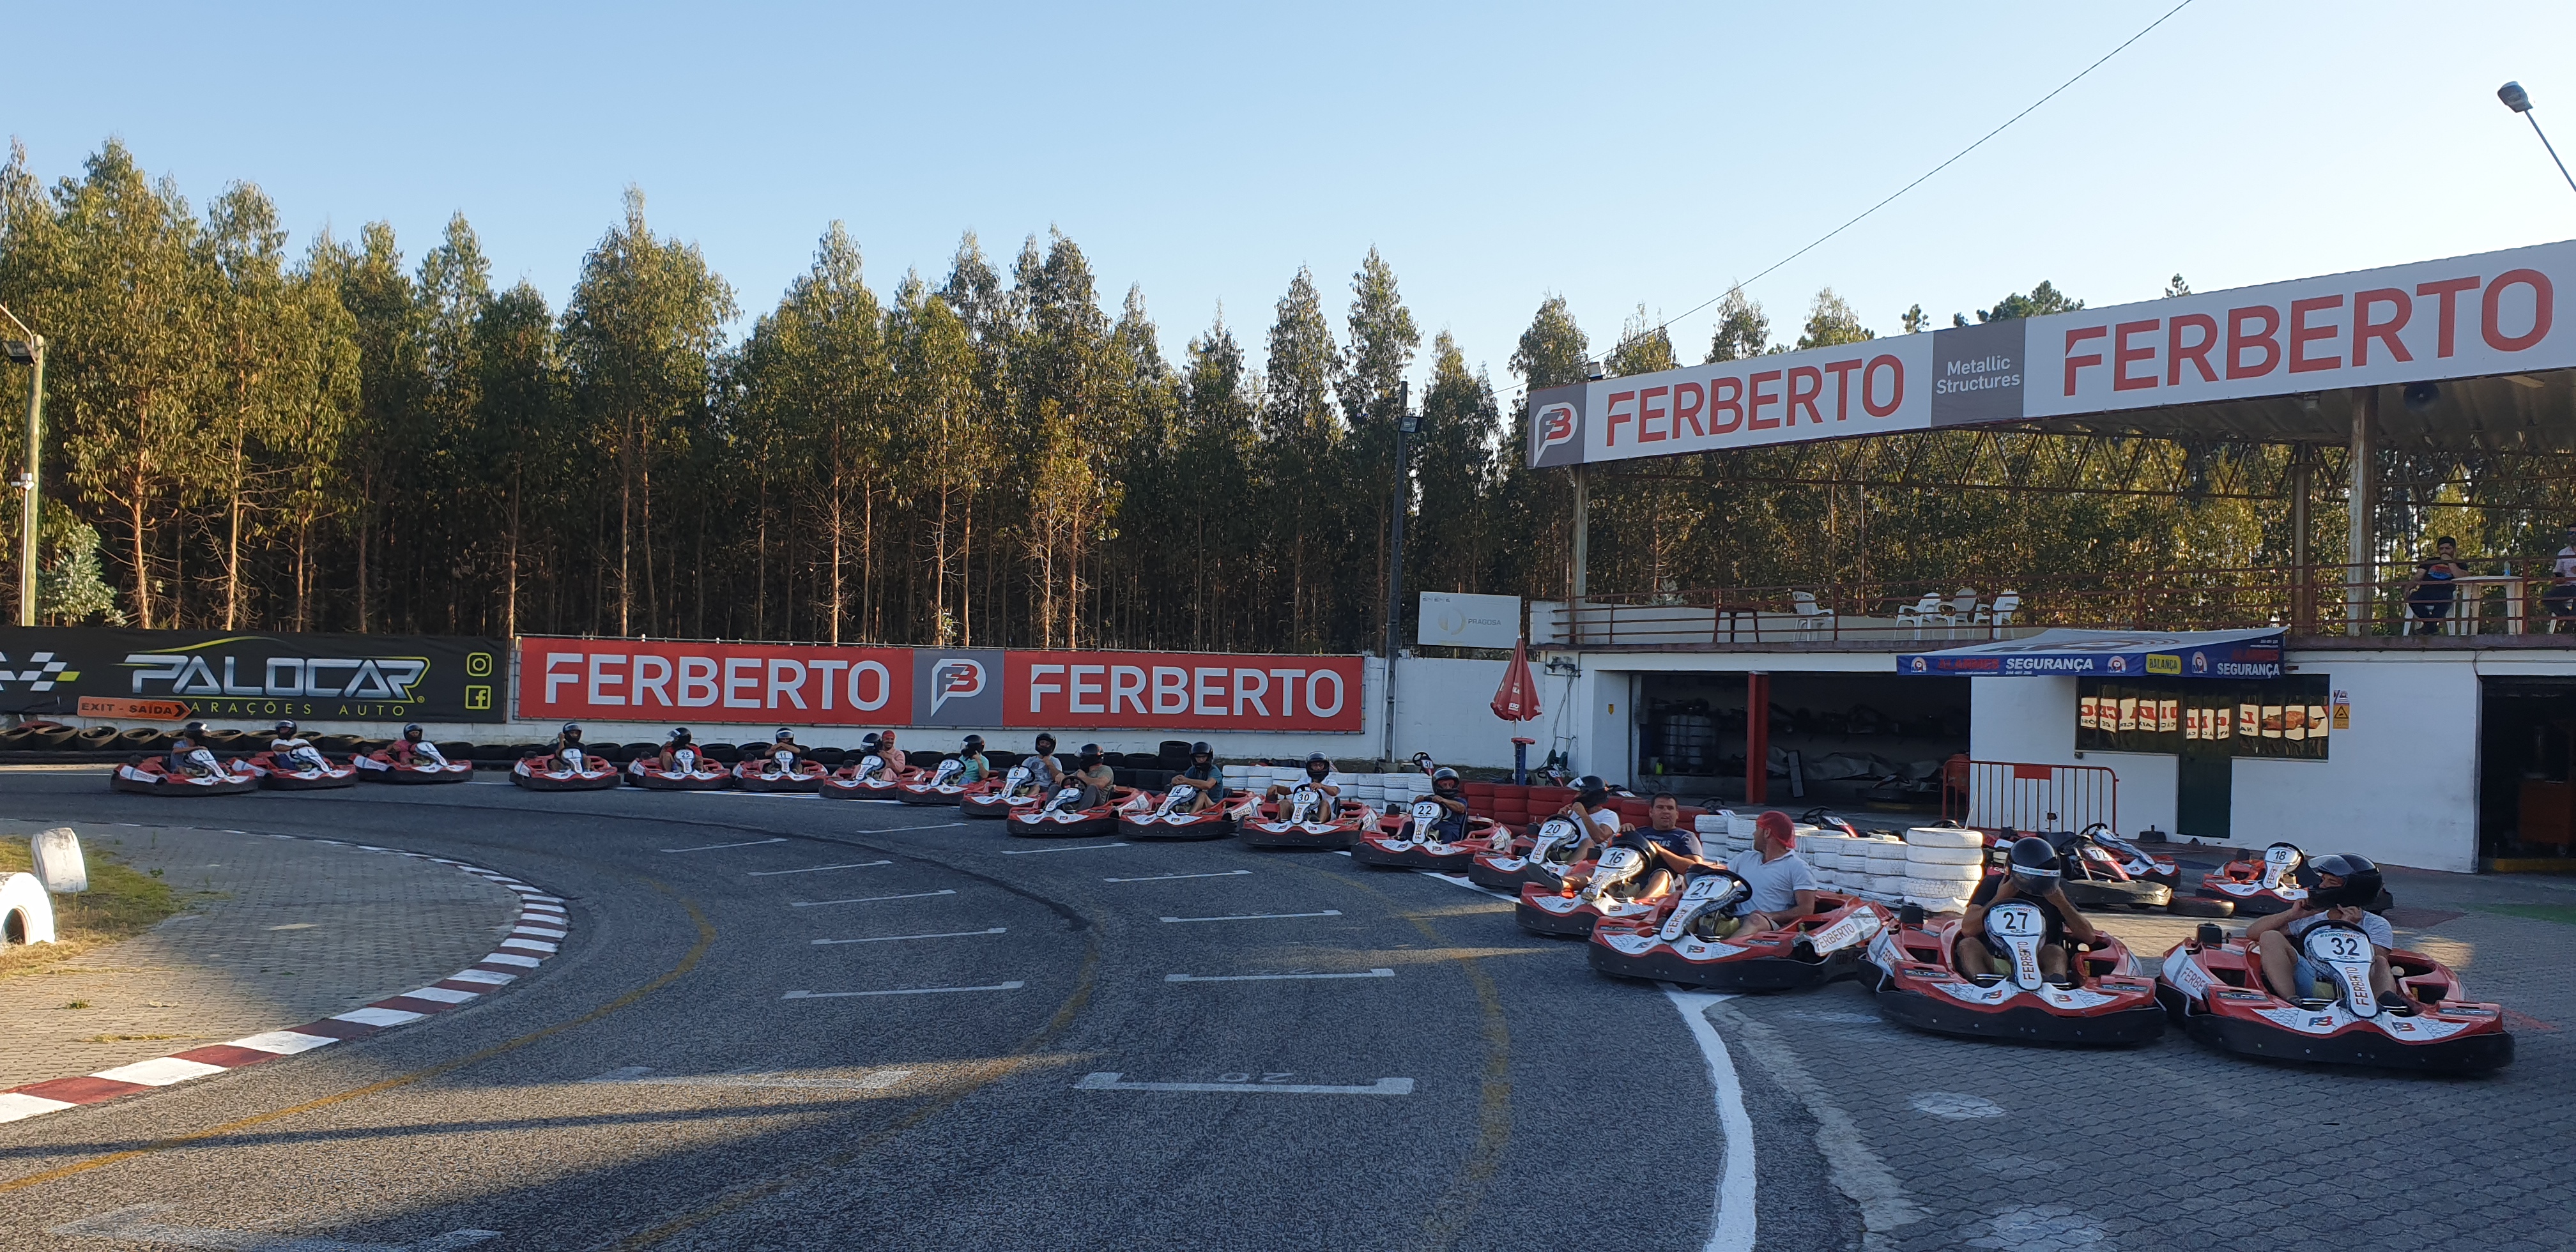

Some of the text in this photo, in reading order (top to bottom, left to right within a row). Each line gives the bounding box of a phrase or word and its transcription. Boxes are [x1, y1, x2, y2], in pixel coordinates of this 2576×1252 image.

[2064, 268, 2554, 397] FERBERTO
[1947, 355, 2011, 376] Metallic
[1936, 374, 2020, 394] Structures
[1606, 354, 1904, 447] FERBERTO
[2005, 658, 2093, 672] SEGURANÇA
[2149, 659, 2178, 671] BALANÇA
[2217, 662, 2280, 678] SEGURANÇA
[125, 654, 424, 698] PALOCAR
[545, 652, 889, 711] FERBERTO
[1031, 664, 1344, 718] FERBERTO
[81, 703, 115, 711] EXIT
[129, 704, 172, 715] SAÍDA
[191, 701, 404, 716] ARAÇÕES AUTO
[1418, 805, 1432, 815] 22
[1545, 824, 1561, 834] 20
[1609, 851, 1625, 863] 16
[2091, 850, 2109, 859] 72
[2274, 850, 2287, 860] 18
[1691, 882, 1715, 895] 21
[2003, 912, 2028, 929] 27
[2331, 937, 2360, 956] 32
[2017, 941, 2035, 981] FERBERTO
[2345, 967, 2369, 1006] FERBERTO
